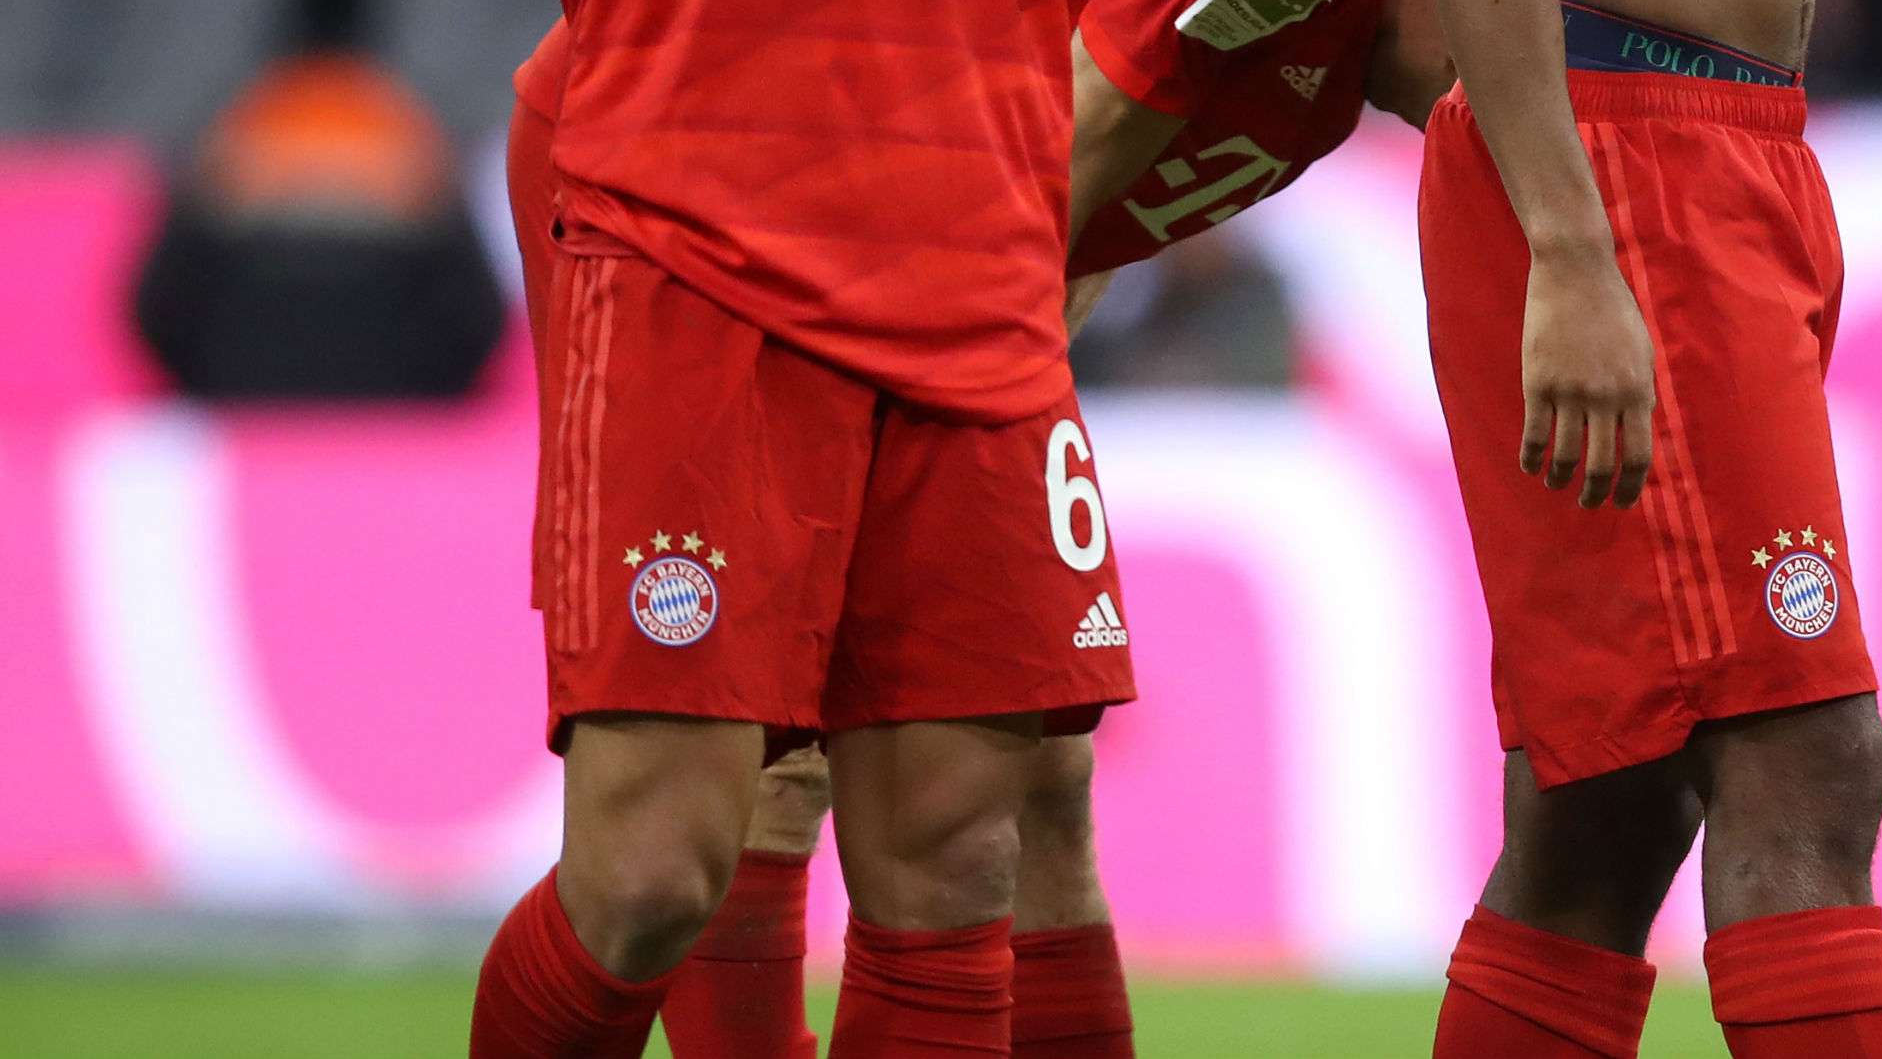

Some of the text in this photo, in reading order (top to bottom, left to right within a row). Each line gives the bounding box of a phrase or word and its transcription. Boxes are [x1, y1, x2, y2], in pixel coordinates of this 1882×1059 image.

[1620, 31, 1717, 79] POLO
[1045, 419, 1107, 572] 6
[1771, 558, 1831, 594] FC BAYERN
[1072, 626, 1129, 649] adidas
